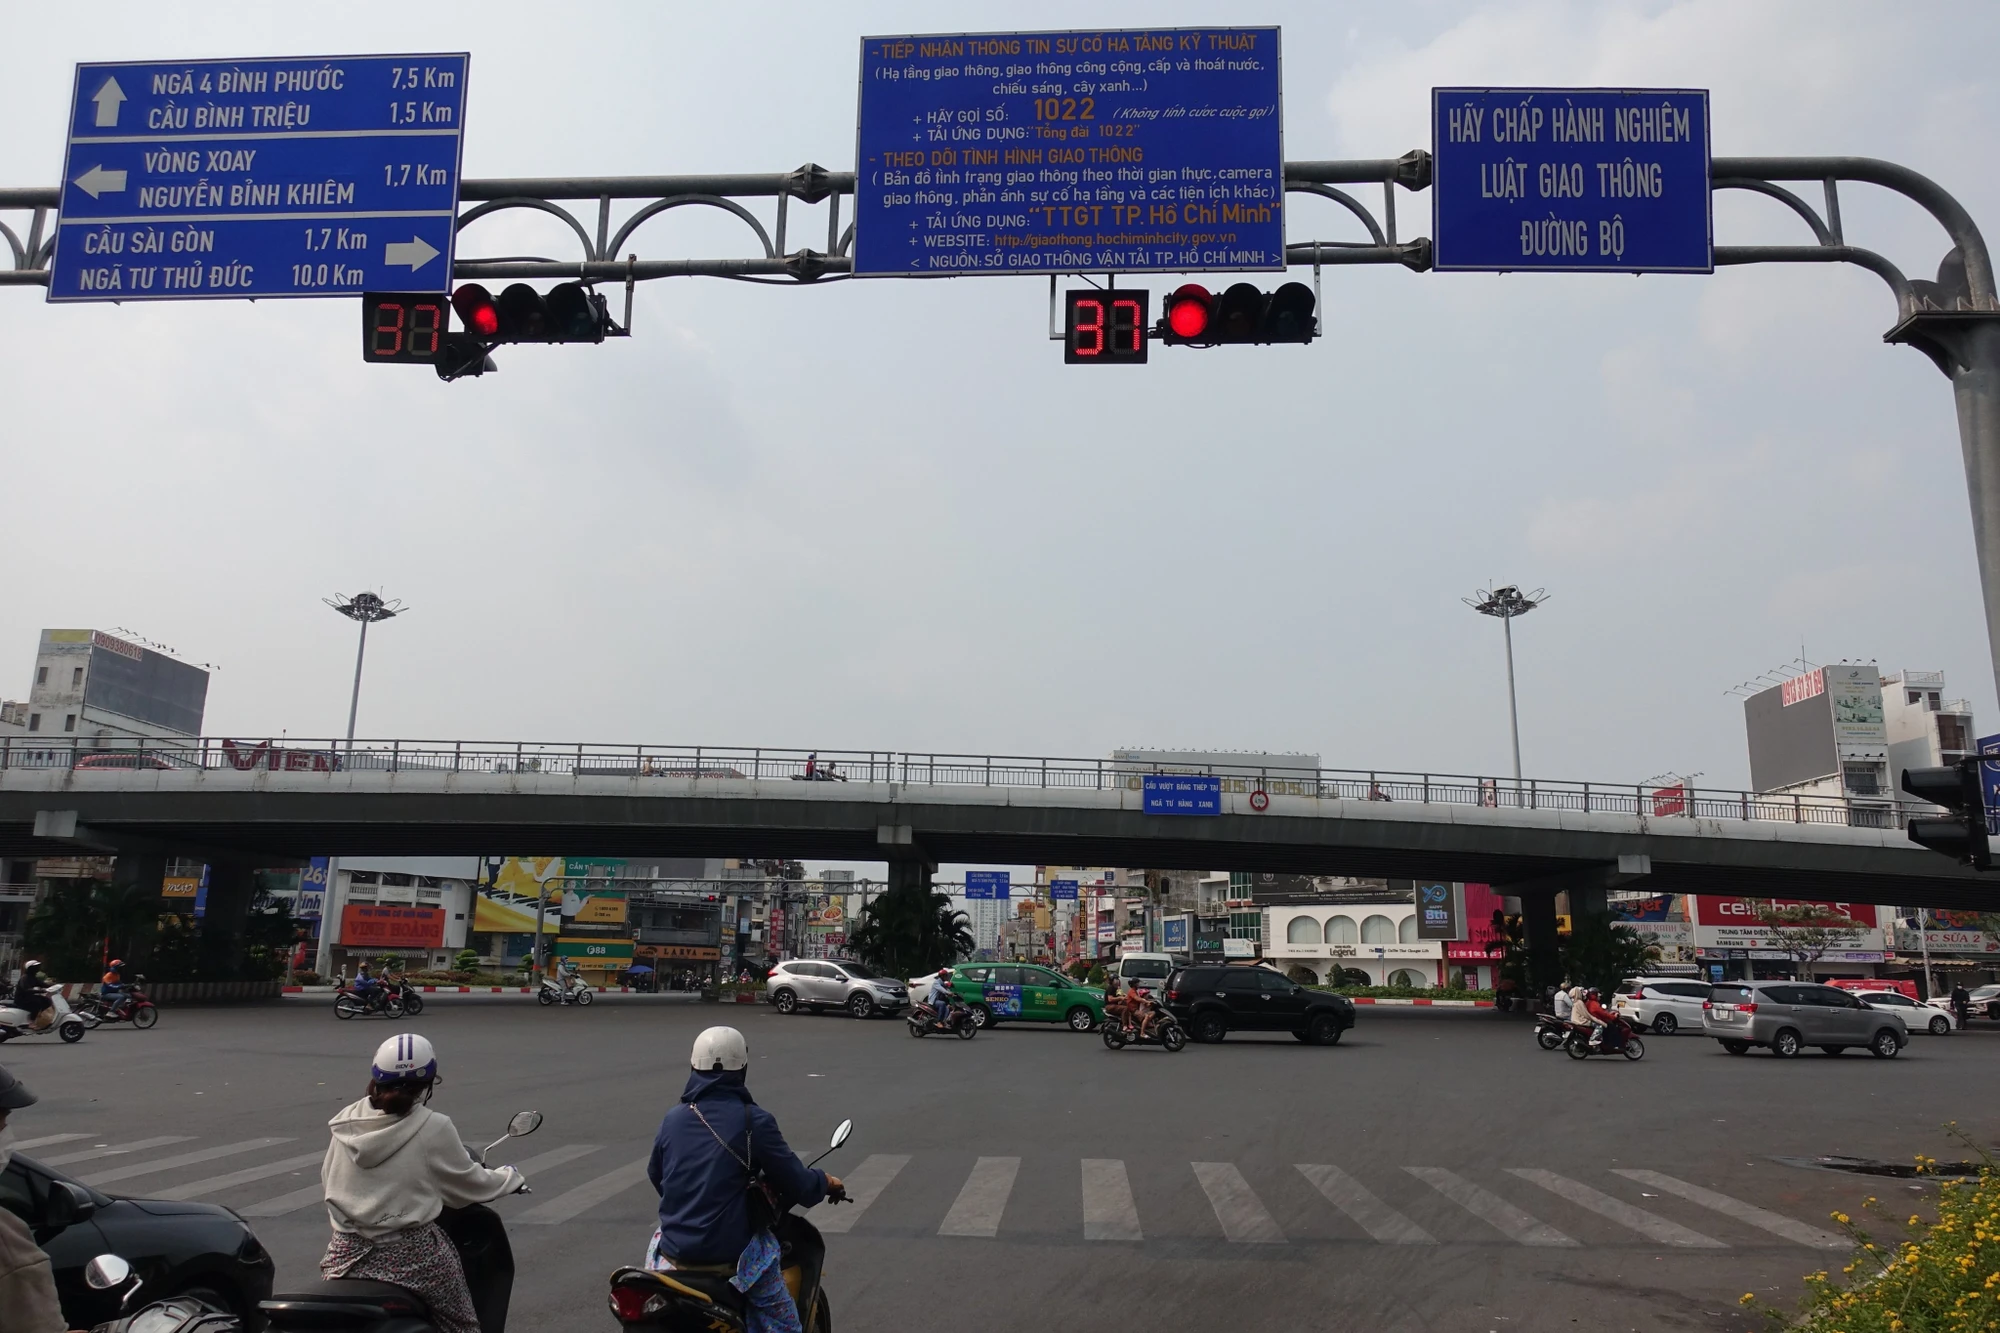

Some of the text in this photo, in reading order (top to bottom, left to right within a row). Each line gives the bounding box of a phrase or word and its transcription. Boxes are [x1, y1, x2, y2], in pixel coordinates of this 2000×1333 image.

[881, 39, 914, 59] TIẾP
[920, 41, 964, 58] NHẬN
[969, 39, 1020, 55] THÔNG
[1026, 39, 1049, 54] TIN
[1056, 38, 1078, 54] SỰ
[1082, 33, 1103, 53] CỐ
[1108, 38, 1129, 53] HẠ
[1180, 32, 1201, 50] KỸ
[1208, 32, 1257, 52] THUẬT
[153, 65, 455, 94] NGÃ 4 BÌNH PHƯỚC 7,5 Km
[904, 65, 930, 80] tầng
[934, 67, 959, 80] giao
[1007, 62, 1031, 76] giao
[1037, 62, 1071, 76] thông
[1076, 61, 1106, 76] công
[1110, 61, 1146, 75] cộng,
[1148, 57, 1170, 74] cấp
[1176, 59, 1190, 70] và
[1195, 57, 1225, 71] thoát
[1228, 57, 1264, 70] nước,
[993, 79, 1026, 94] chiếu
[1031, 81, 1067, 95] sáng,
[1074, 80, 1095, 95] cây
[149, 101, 452, 130] CẦU BÌNH TRIỆU 1,5 Km
[927, 108, 953, 124] HÃY
[986, 103, 1008, 121] SỐ:
[1034, 97, 1095, 120] 1022
[1113, 107, 1160, 120] (Không
[1163, 103, 1185, 117] tính
[1189, 104, 1216, 117] cước
[1220, 107, 1246, 120] cuộc
[1249, 104, 1275, 120] gọi)
[1450, 95, 1690, 142] HÃY CHẤP HÀNH NGHIÊM
[145, 147, 256, 173] VÒNG XOAY
[884, 146, 1143, 167] THEO DÕI TÌNH HÌNH GIAO THÔNG
[384, 165, 447, 188] 1,7 Km
[915, 168, 931, 185] đồ
[936, 168, 960, 184] tình
[965, 171, 1001, 186] trạng
[1007, 172, 1034, 185] giao
[1040, 169, 1078, 184] thông
[1083, 168, 1112, 181] theo
[1118, 166, 1143, 181] thời
[1149, 169, 1176, 183] gian
[1219, 168, 1272, 179] camera
[1481, 157, 1662, 203] LUẬT GIAO THÔNG
[139, 178, 355, 208] NGUYỄN BỈNH KHIÊM
[926, 212, 946, 228] TẢI
[952, 210, 981, 228] ỨNG
[987, 215, 1030, 230] DỤNG:
[1112, 205, 1144, 225] TP.
[1150, 202, 1178, 225] Hồ
[1184, 200, 1216, 224] Chí
[85, 225, 367, 254] CẦU SÀI GÒN 1,7 Km
[924, 234, 989, 247] WEBSITE:
[1520, 212, 1624, 261] ĐƯỜNG BỘ
[929, 251, 982, 268] NGUỒN:
[984, 249, 1003, 267] SỞ
[1008, 253, 1040, 266] GIAO
[1044, 250, 1092, 266] THÔNG
[1097, 249, 1124, 267] VẬN
[1129, 247, 1149, 265] TẢI
[1203, 246, 1226, 264] CHÍ
[1230, 251, 1264, 263] MINH
[80, 259, 364, 290] NGÃ TƯ THỦ ĐỨC 10,0 Km
[374, 303, 440, 355] 37
[1076, 300, 1141, 355] 37
[95, 633, 142, 659] 0909380618
[1159, 783, 1174, 791] VƯỢT
[1193, 782, 1207, 791] THÉP
[1210, 784, 1219, 792] TẠI
[1151, 799, 1162, 807] NGÃ
[1178, 799, 1193, 808] HÀNG
[1424, 909, 1448, 920] 8th
[1943, 932, 1968, 943] SỮA
[1973, 936, 1981, 944] 2
[1330, 948, 1357, 958] Legend
